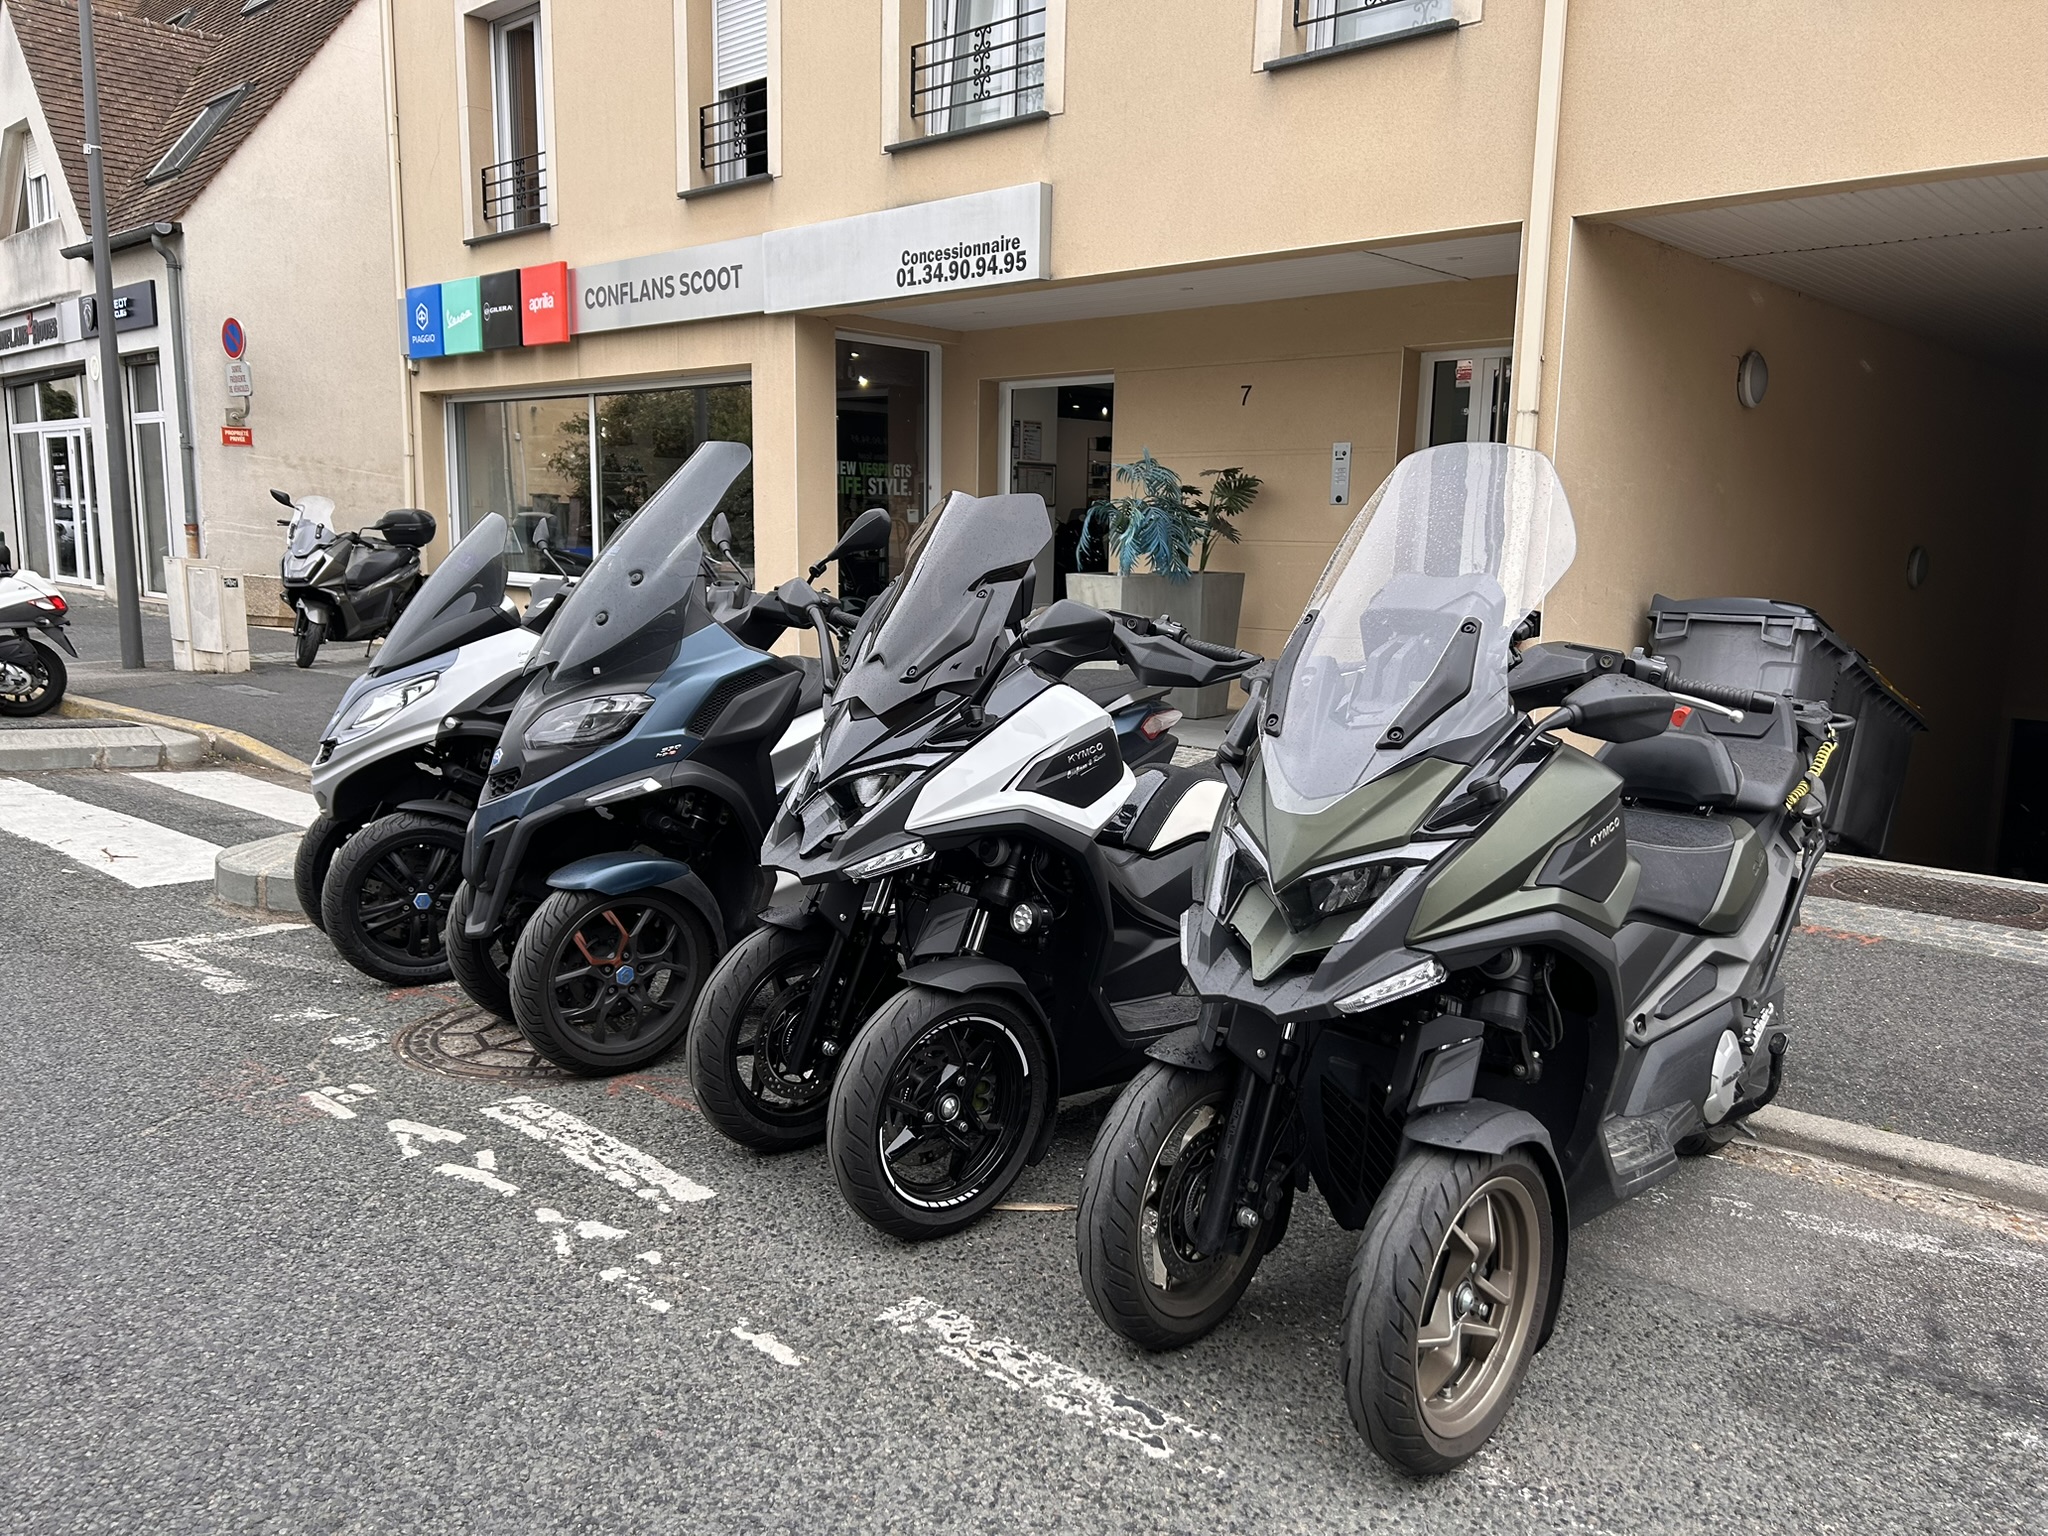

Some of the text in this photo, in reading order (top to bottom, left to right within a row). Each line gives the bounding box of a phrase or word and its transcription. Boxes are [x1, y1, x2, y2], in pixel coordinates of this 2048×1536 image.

[901, 234, 1021, 266] Concessionnaire
[896, 250, 1027, 288] 01.34.90.94.95
[584, 264, 743, 309] CONFLANS SCOOT
[489, 305, 513, 314] GILERA
[528, 292, 554, 313] aprilia
[446, 309, 473, 329] Vespa
[412, 334, 436, 344] PIAGGIO
[1240, 384, 1253, 406] 7
[893, 463, 912, 478] GTS
[867, 477, 912, 496] STYLE.
[1067, 742, 1104, 764] KYMCO
[1590, 816, 1620, 848] KYMCO
